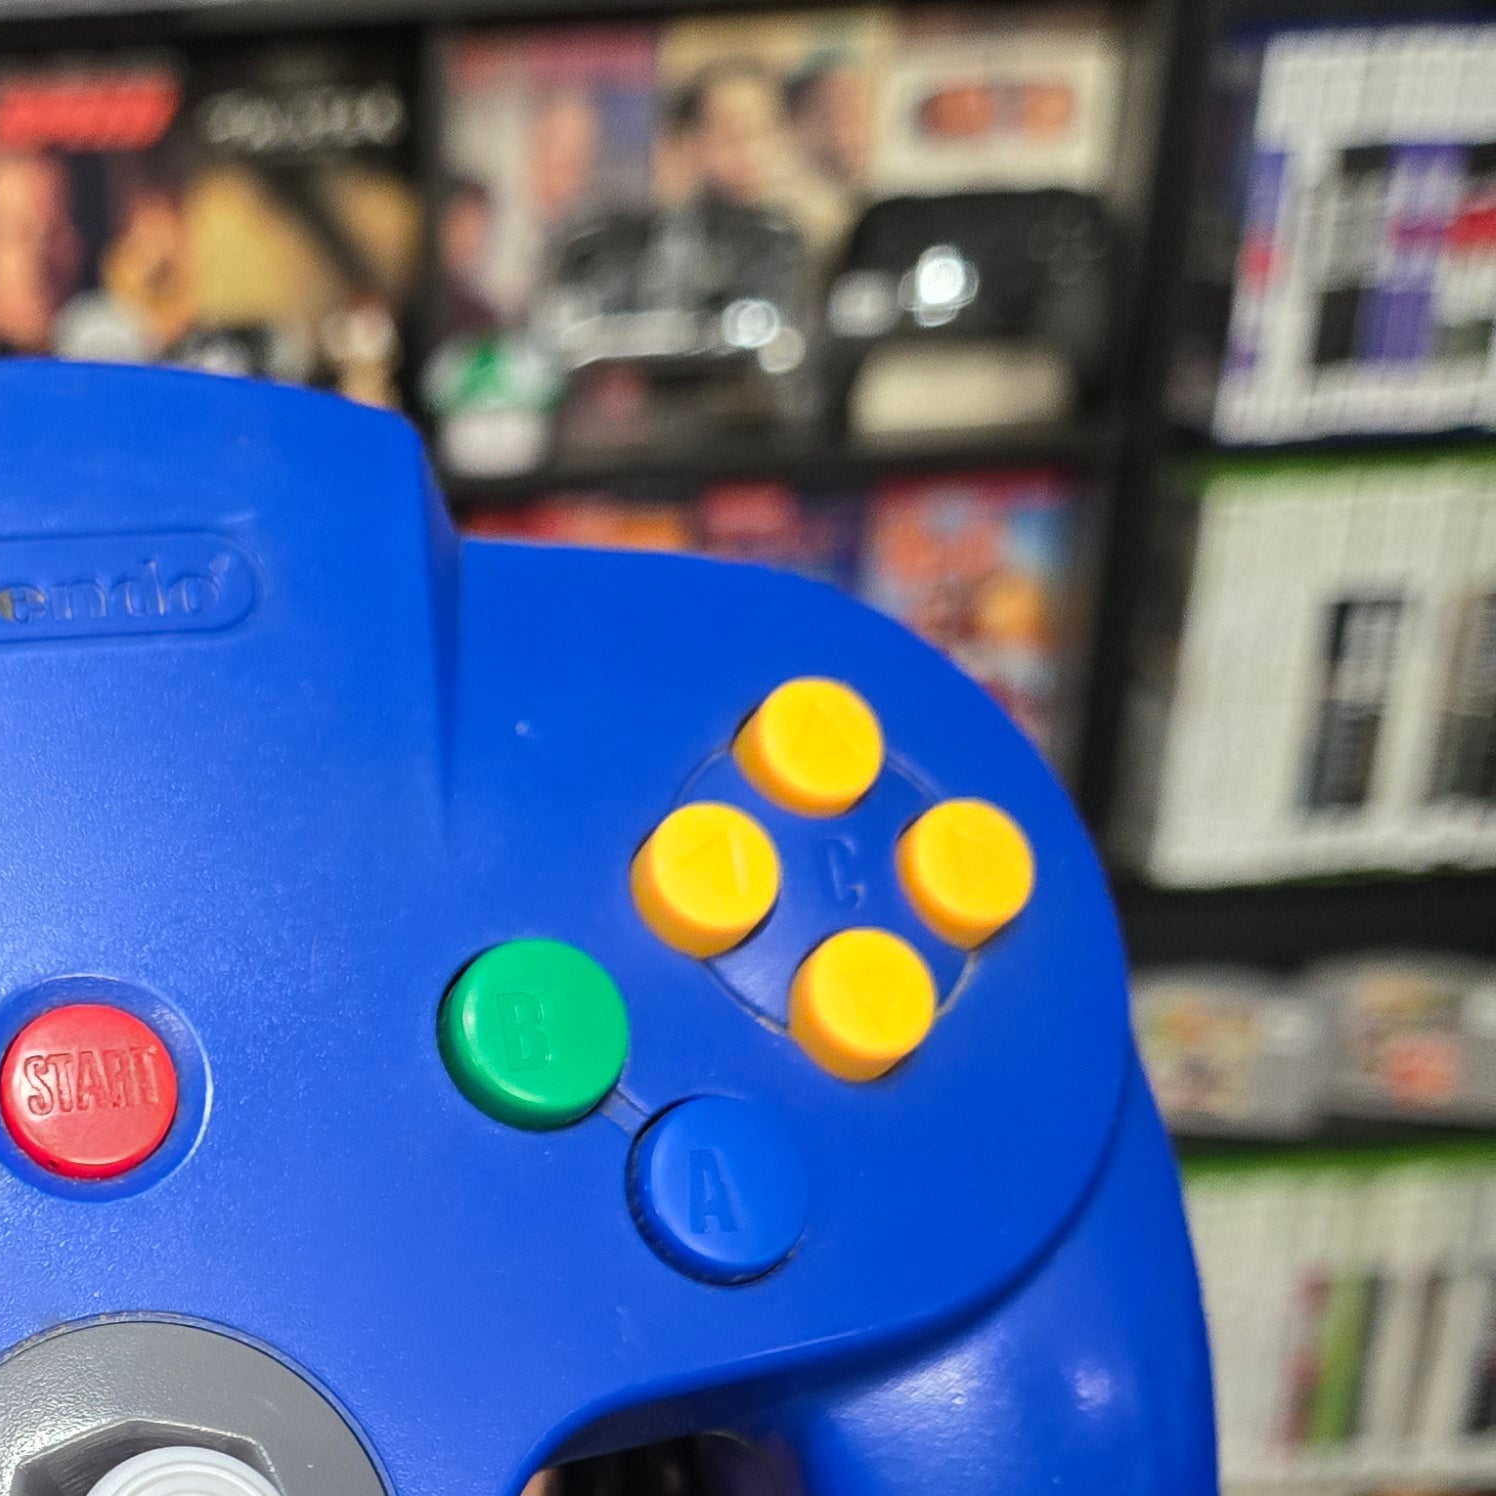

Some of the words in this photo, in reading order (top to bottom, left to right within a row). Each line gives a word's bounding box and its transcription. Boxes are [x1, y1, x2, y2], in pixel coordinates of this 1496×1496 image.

[821, 835, 865, 911] C
[497, 991, 552, 1073] B
[23, 1046, 160, 1116] START
[689, 1148, 737, 1234] A
